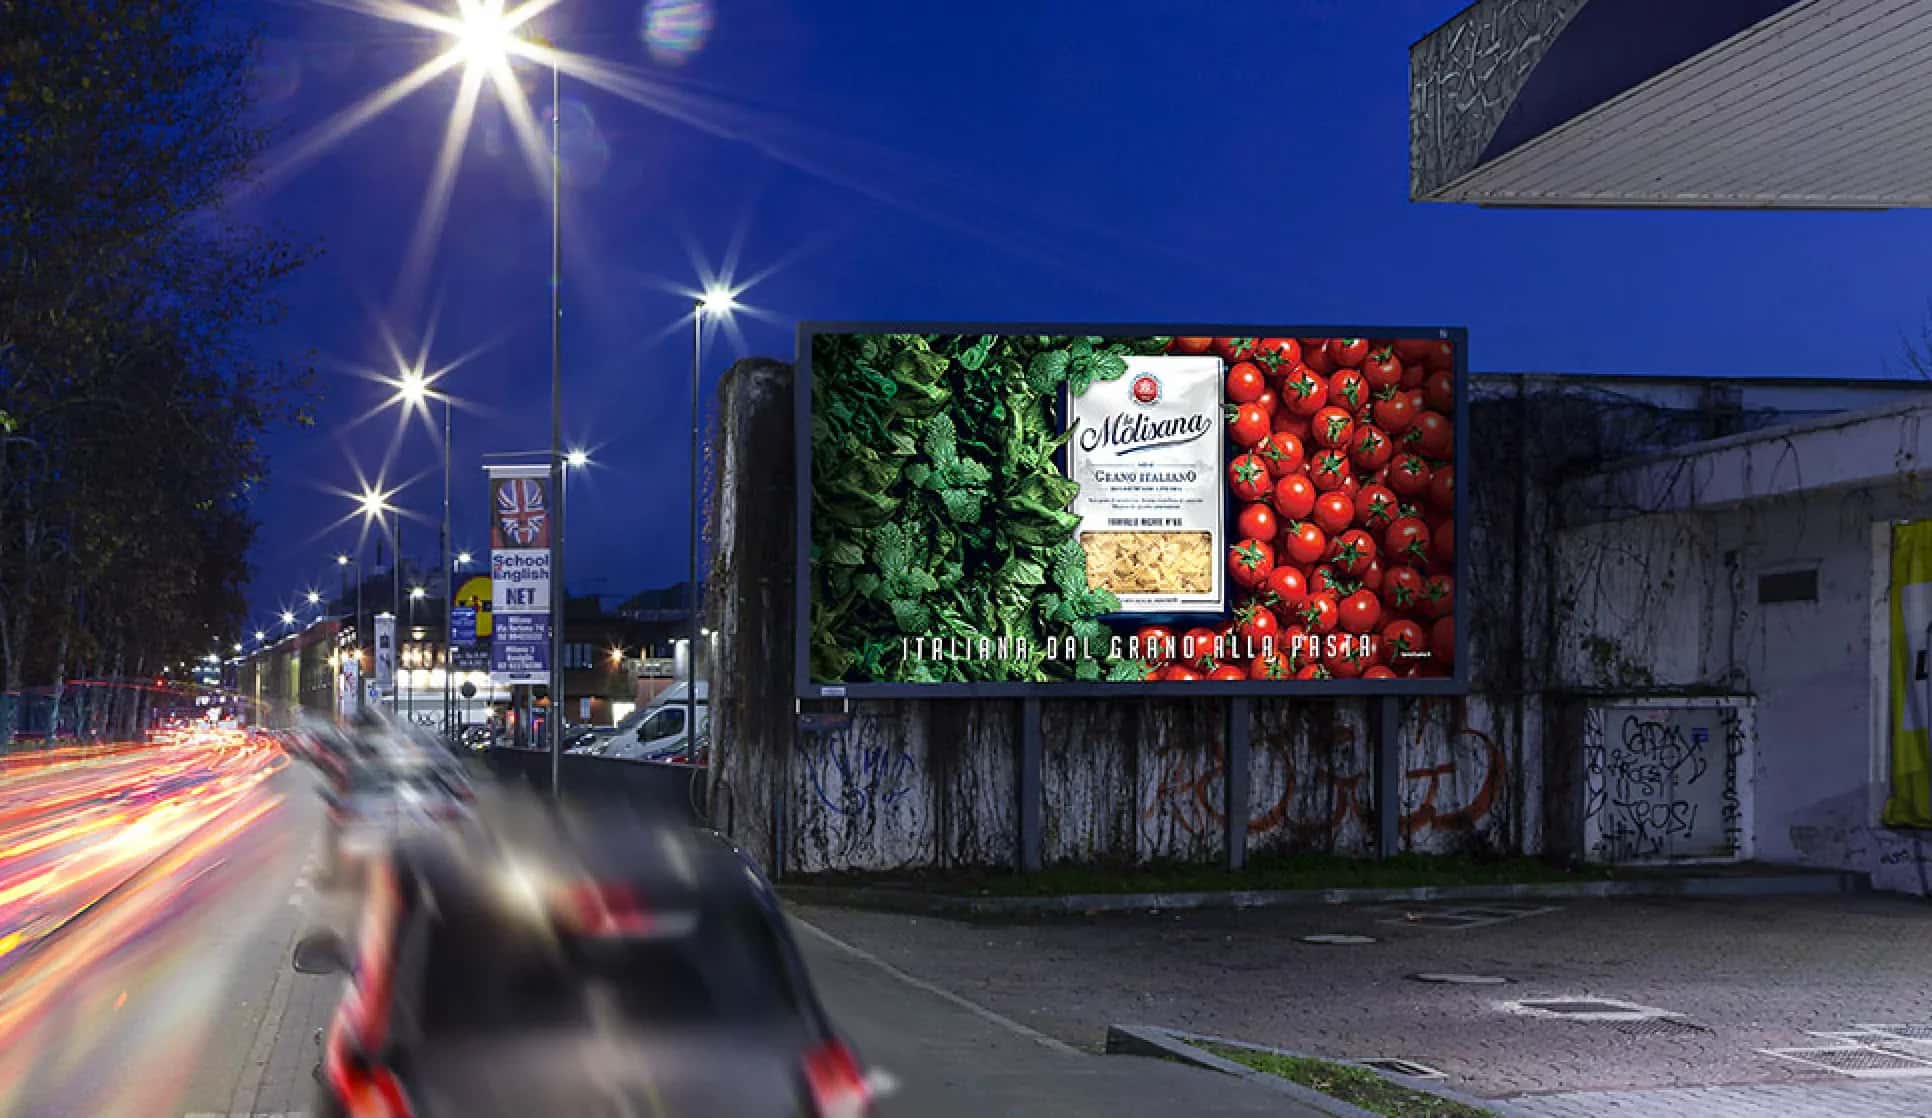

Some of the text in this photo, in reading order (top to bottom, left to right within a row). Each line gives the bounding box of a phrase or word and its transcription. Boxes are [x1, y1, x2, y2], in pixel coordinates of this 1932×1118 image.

[1080, 412, 1213, 456] Molisana
[1139, 469, 1197, 482] ITALIANO
[493, 554, 549, 567] School
[493, 567, 549, 582] English
[505, 587, 536, 605] NET
[903, 634, 1371, 661] ITALIANA DAL GRANO ALLA PASTA
